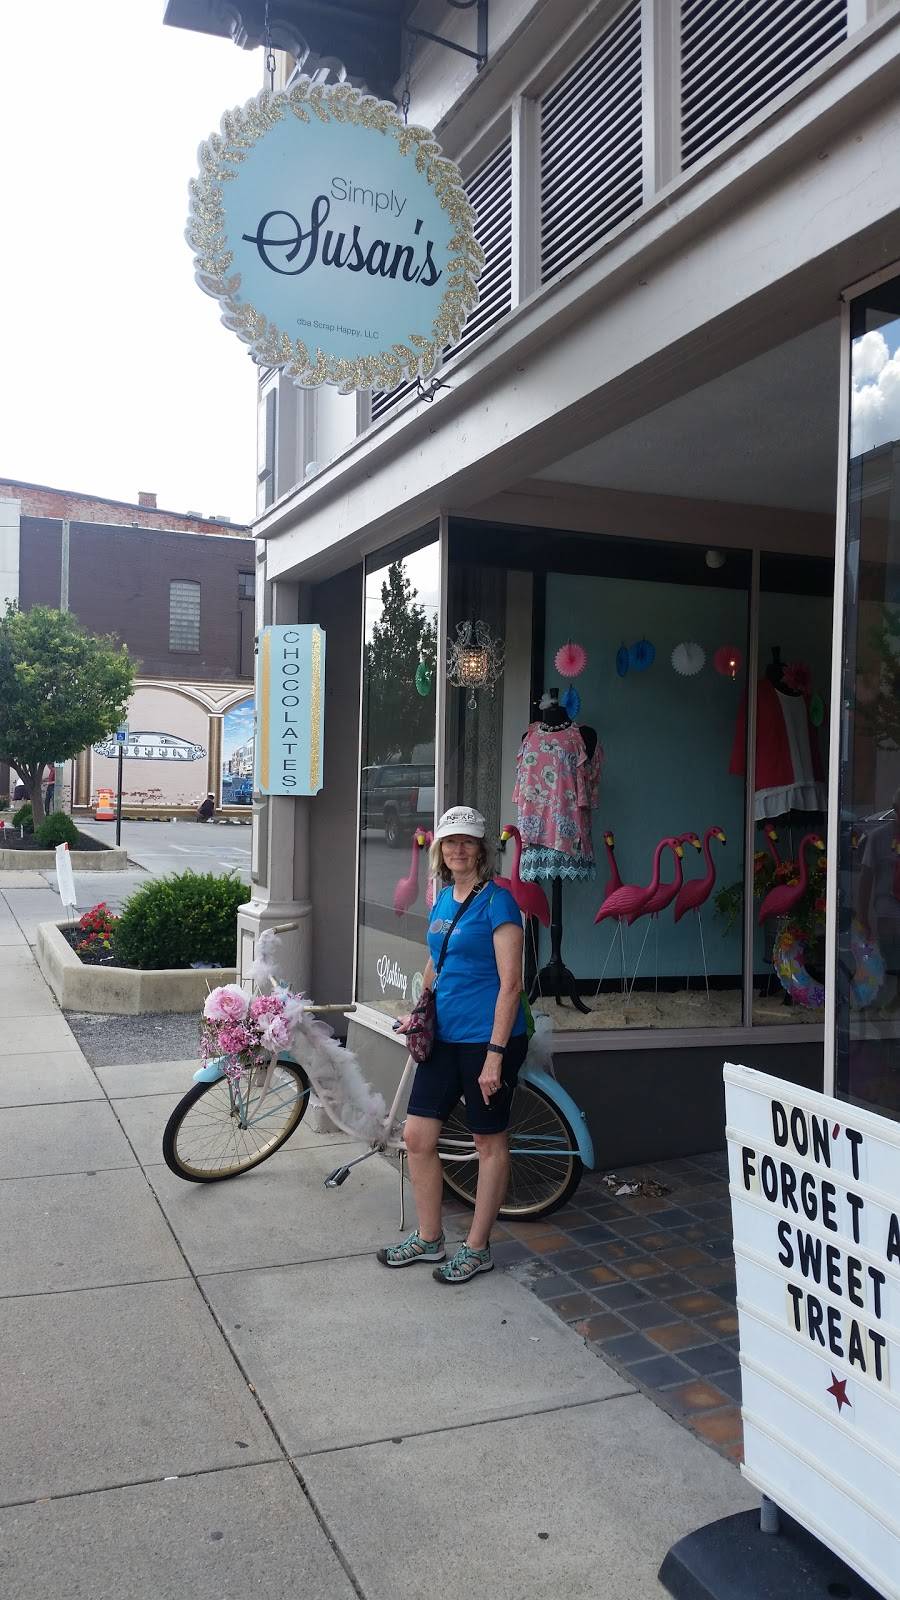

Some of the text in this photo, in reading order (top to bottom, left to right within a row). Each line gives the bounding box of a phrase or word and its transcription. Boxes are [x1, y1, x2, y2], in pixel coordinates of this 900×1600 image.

[242, 195, 443, 287] Susan's
[330, 177, 407, 217] Simply
[296, 318, 312, 327] dba
[313, 320, 335, 331] Scrap
[364, 329, 379, 339] LLC
[281, 631, 300, 787] CHOCOLATES
[376, 954, 408, 999] Clothing
[771, 1100, 864, 1181] DON'T
[741, 1146, 900, 1264] FORGET A
[777, 1220, 886, 1319] SWEET
[787, 1283, 887, 1382] TREAT
